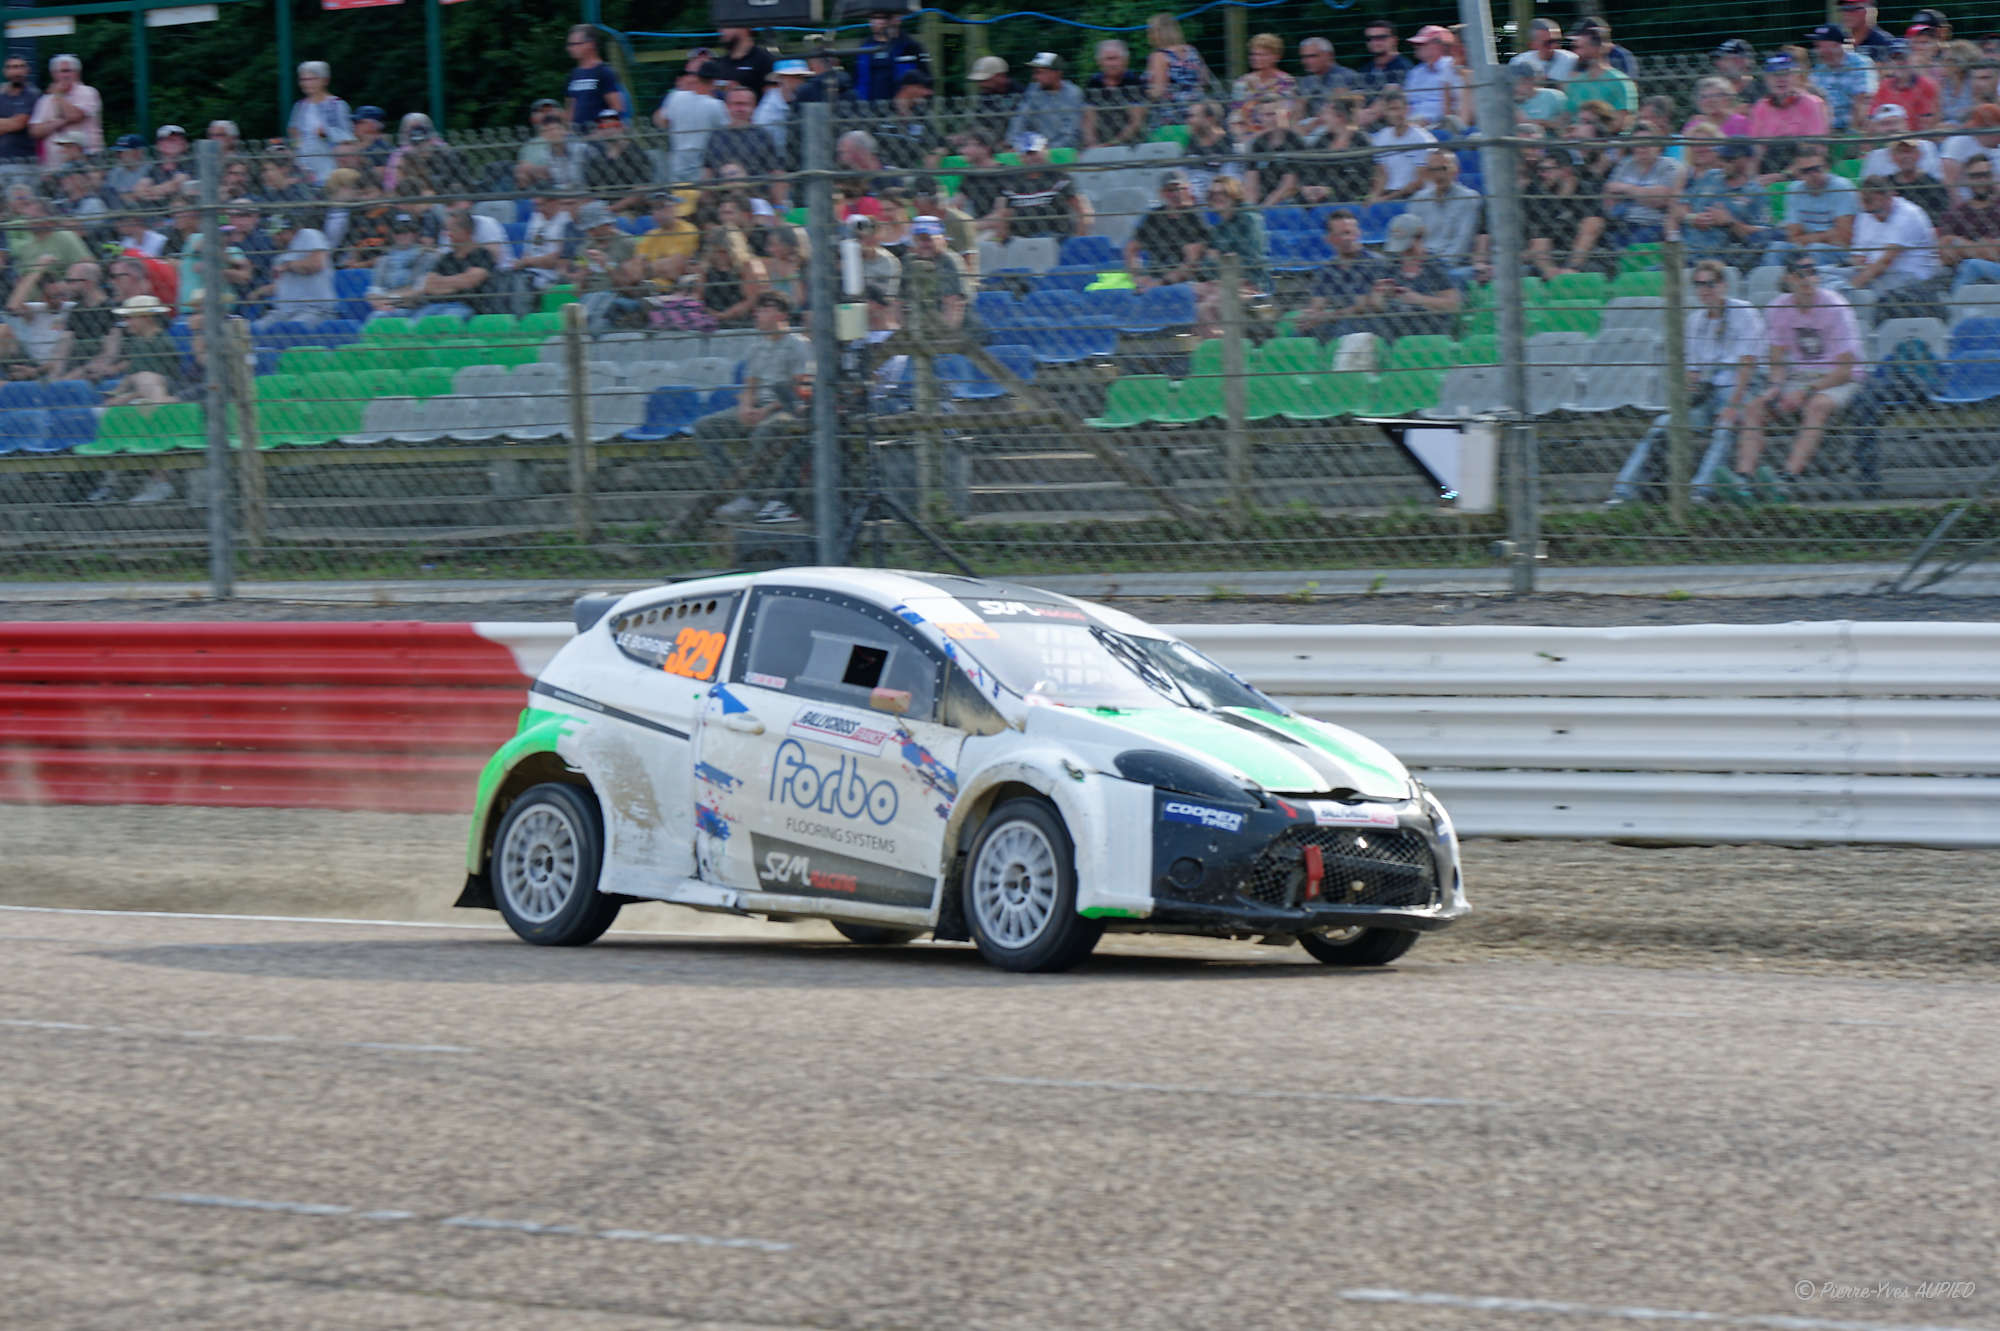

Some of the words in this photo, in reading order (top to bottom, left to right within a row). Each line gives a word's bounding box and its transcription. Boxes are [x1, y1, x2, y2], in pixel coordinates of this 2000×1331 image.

[664, 627, 726, 680] 329
[802, 711, 861, 735] RALLYCROSS
[769, 738, 899, 826] forbo
[1165, 802, 1242, 822] COOPER
[786, 817, 843, 842] FLOORING
[845, 830, 896, 854] SYSTEMS
